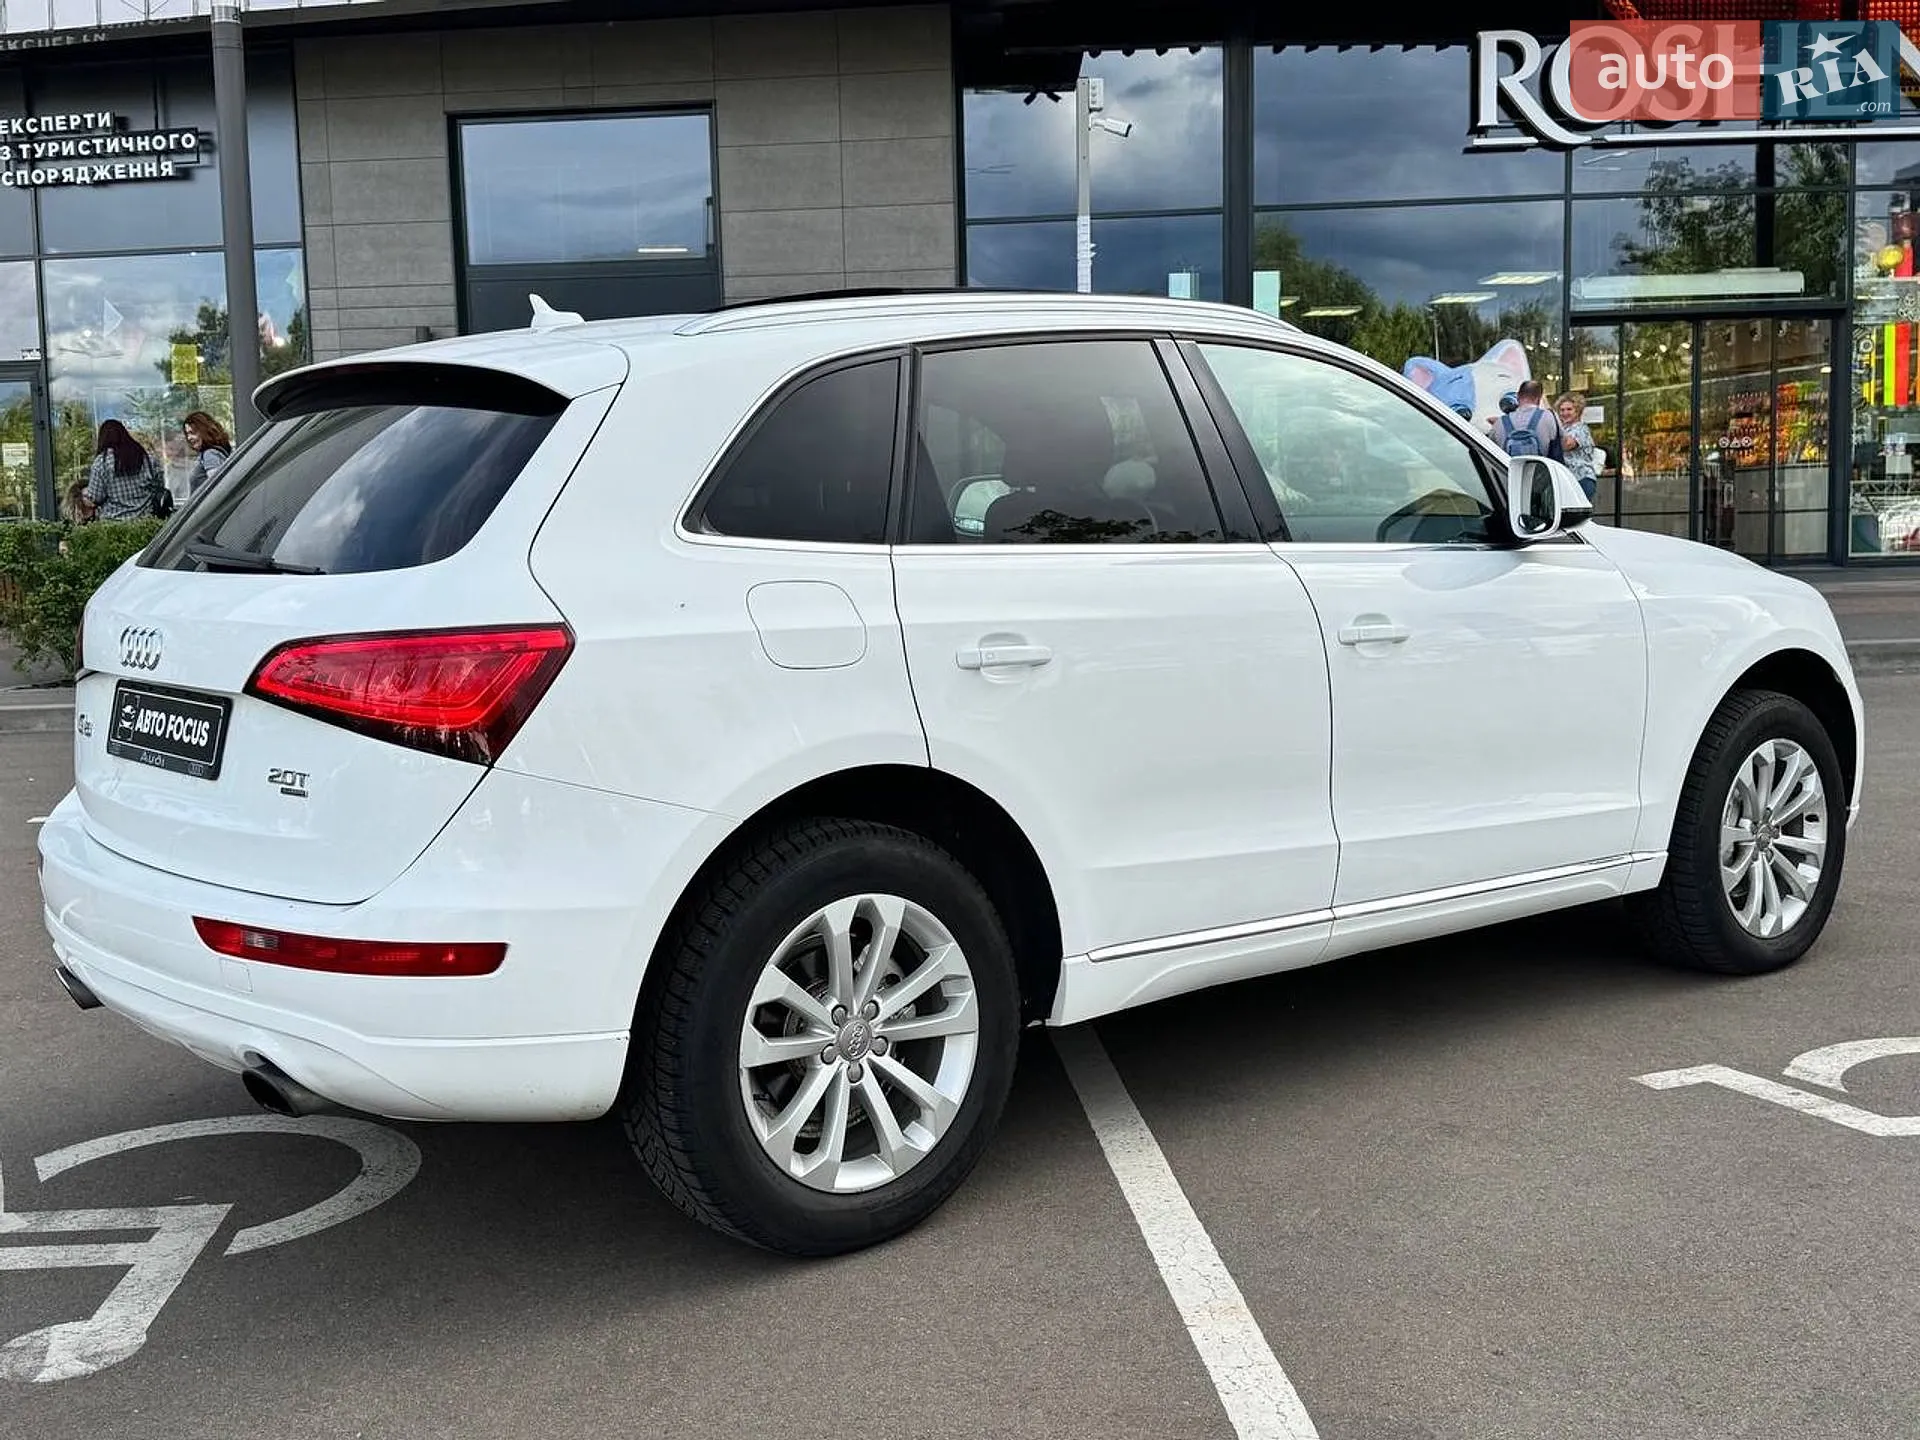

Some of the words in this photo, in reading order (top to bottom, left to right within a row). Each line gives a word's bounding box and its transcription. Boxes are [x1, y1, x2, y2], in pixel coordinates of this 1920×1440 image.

[0, 111, 113, 135] ЕКСПЕРТИ
[19, 132, 197, 160] ТУРИСТИЧНОГО
[1, 161, 175, 187] СПОРЯДЖЕННЯ
[166, 715, 210, 747] FOCUS
[140, 751, 166, 768] Audi
